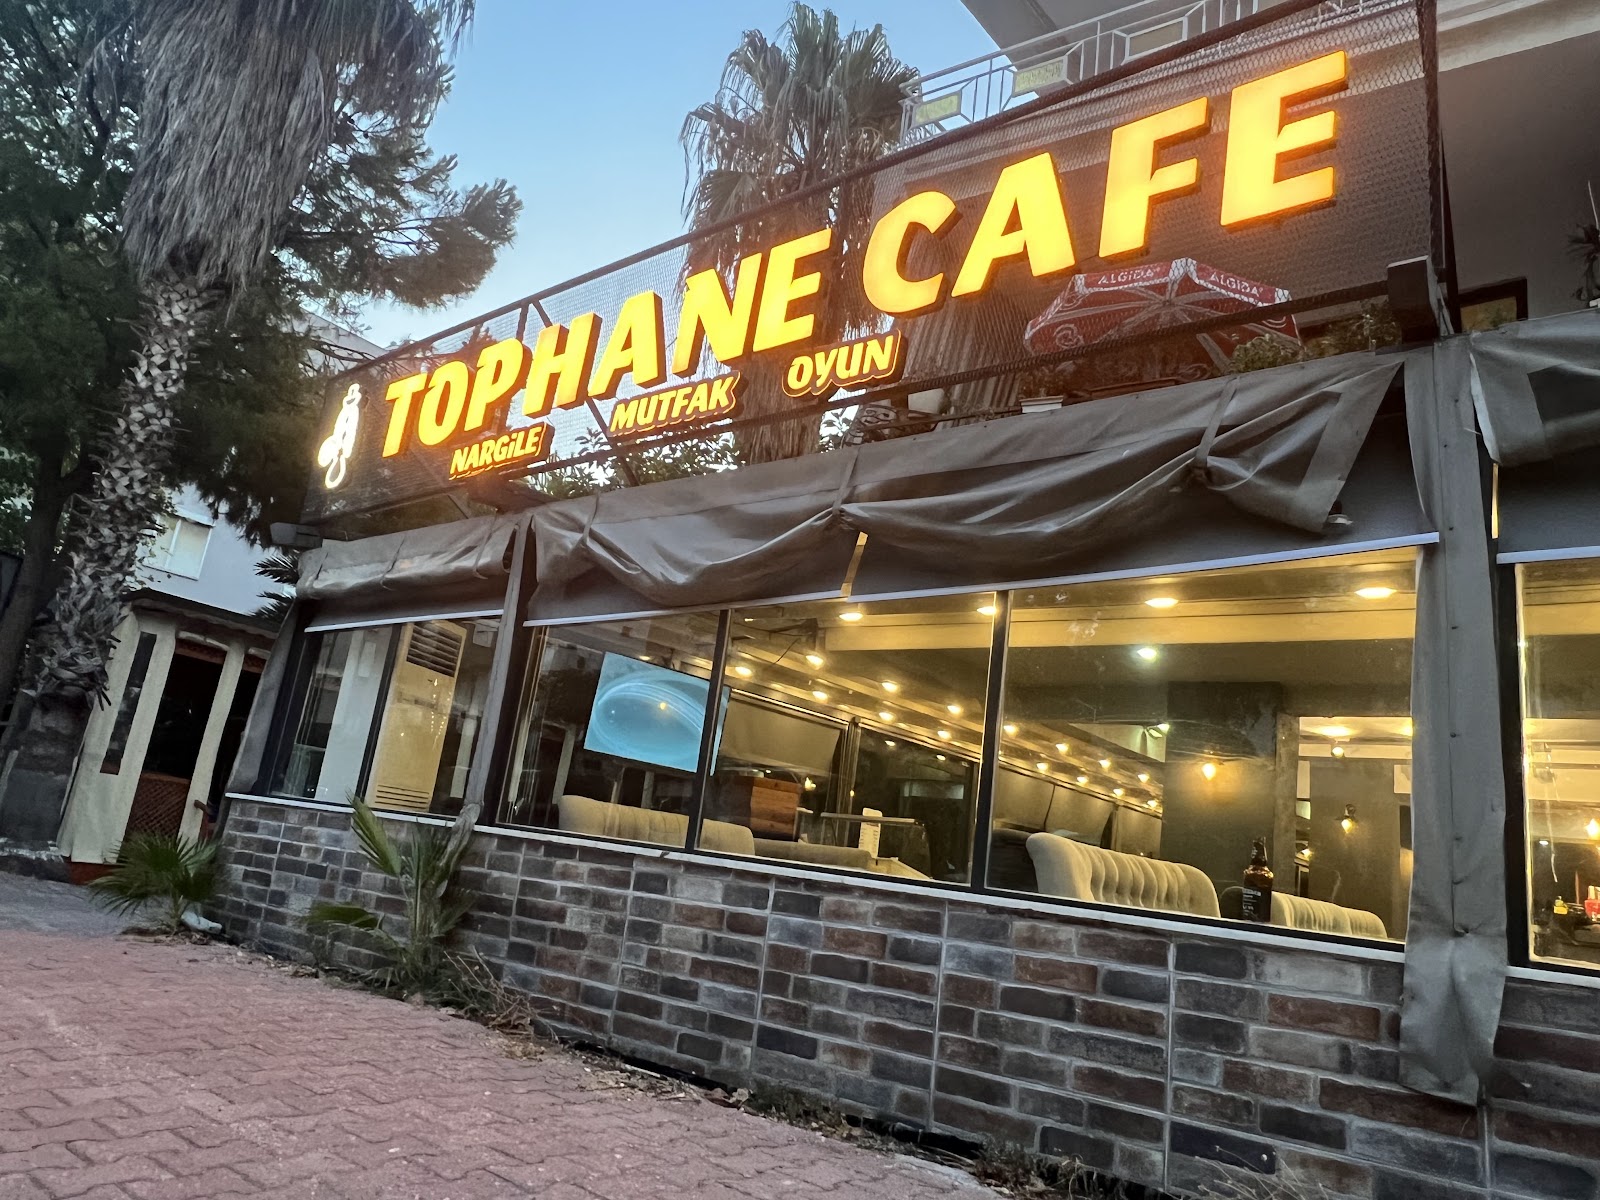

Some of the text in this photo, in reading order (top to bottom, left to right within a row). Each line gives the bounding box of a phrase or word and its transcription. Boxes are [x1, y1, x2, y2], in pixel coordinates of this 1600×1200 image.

[382, 50, 1347, 457] TOPHANE CAFE
[610, 376, 734, 431] MUTFAK
